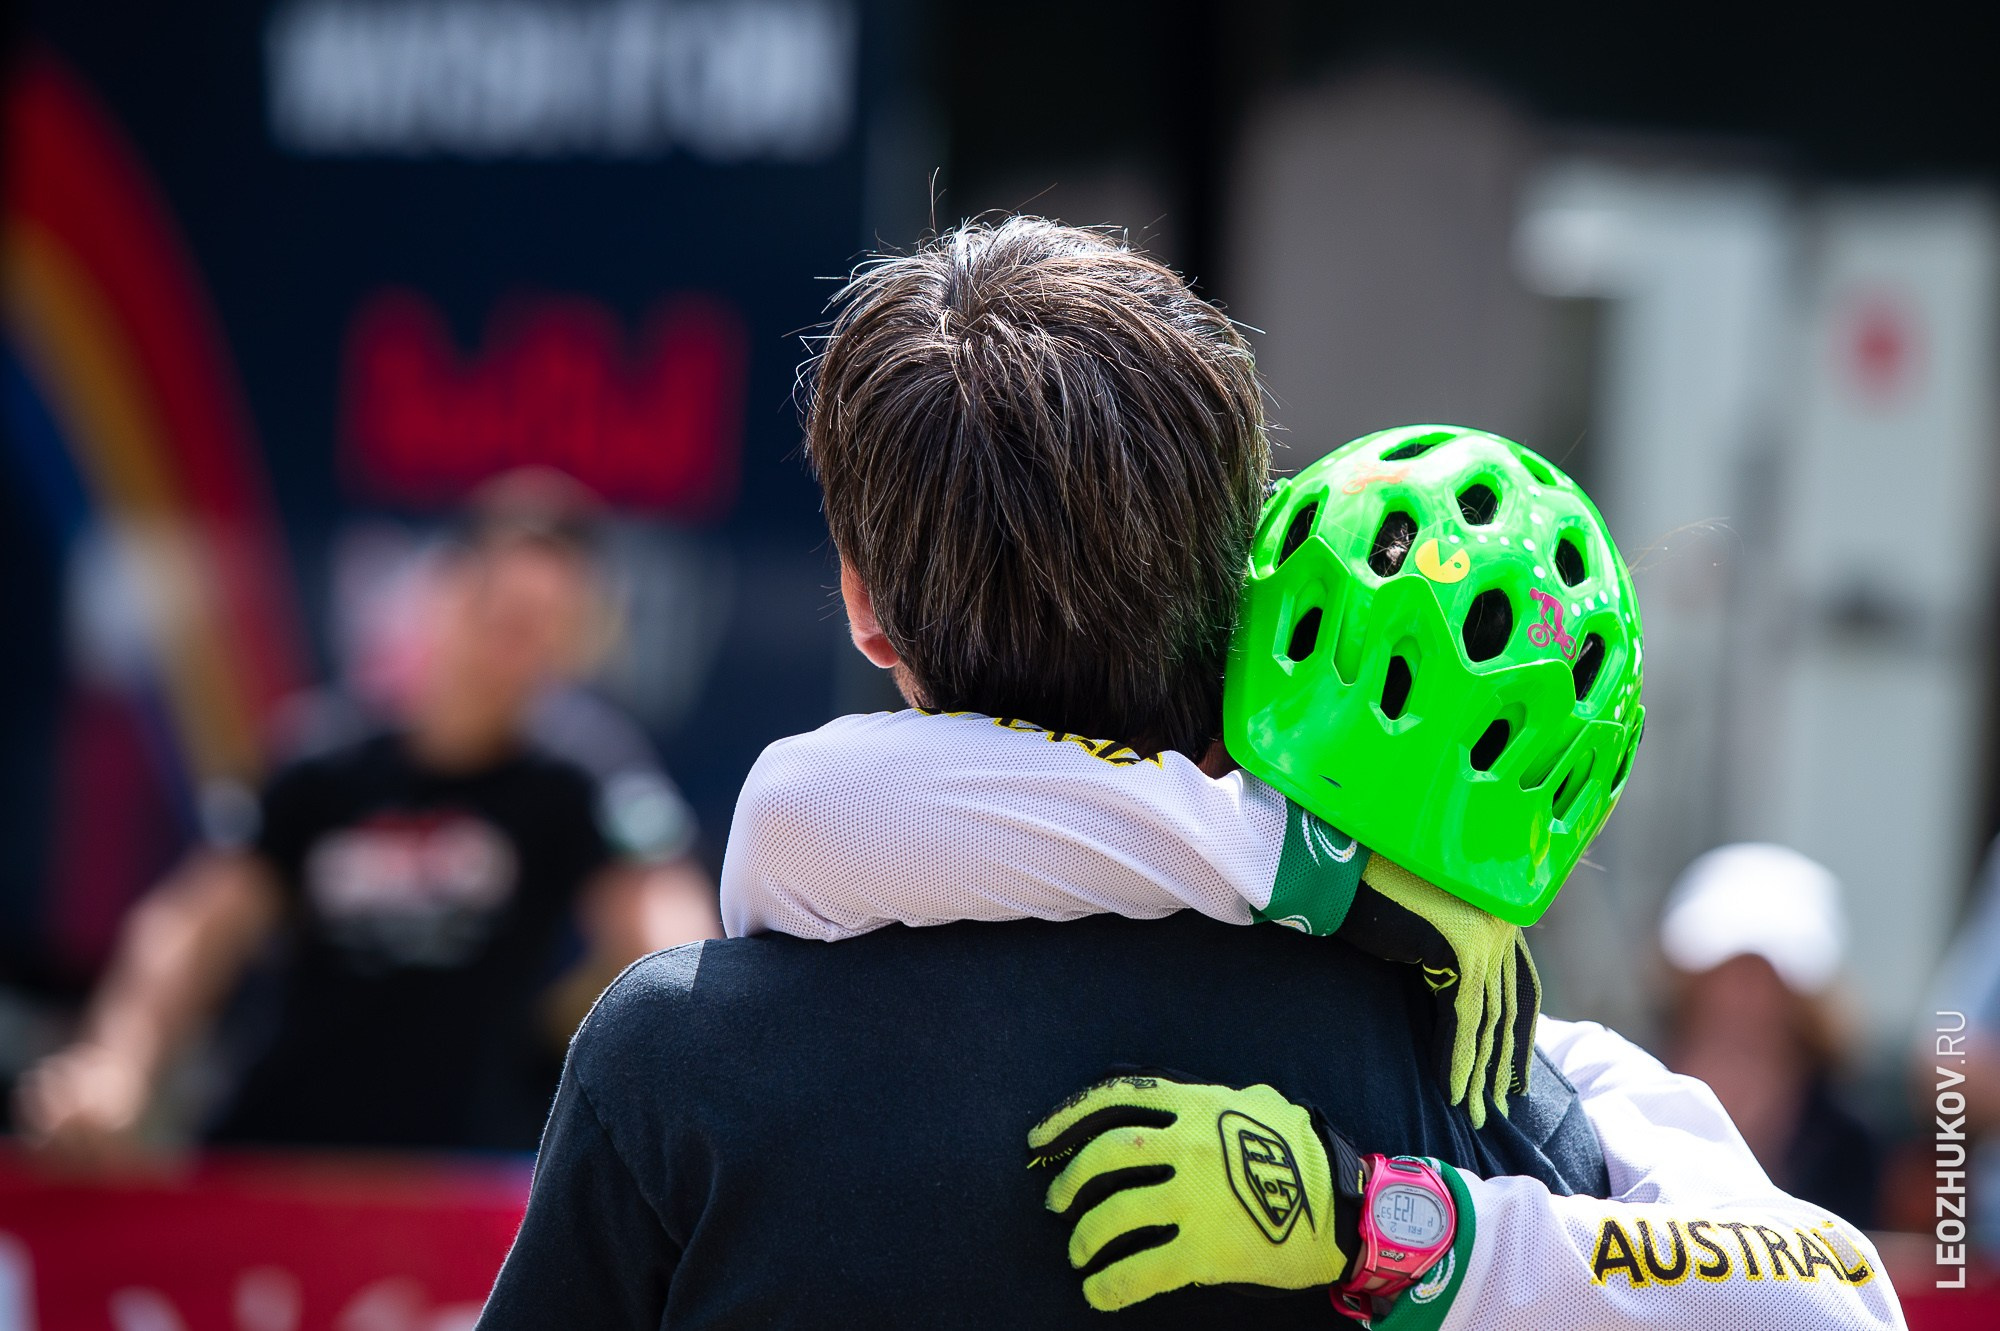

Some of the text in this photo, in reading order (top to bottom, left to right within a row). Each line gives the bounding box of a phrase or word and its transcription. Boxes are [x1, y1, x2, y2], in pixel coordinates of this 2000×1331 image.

[1390, 1221, 1397, 1233] 2
[1408, 1225, 1422, 1235] FRI
[1590, 1217, 1876, 1289] AUSTRAL
